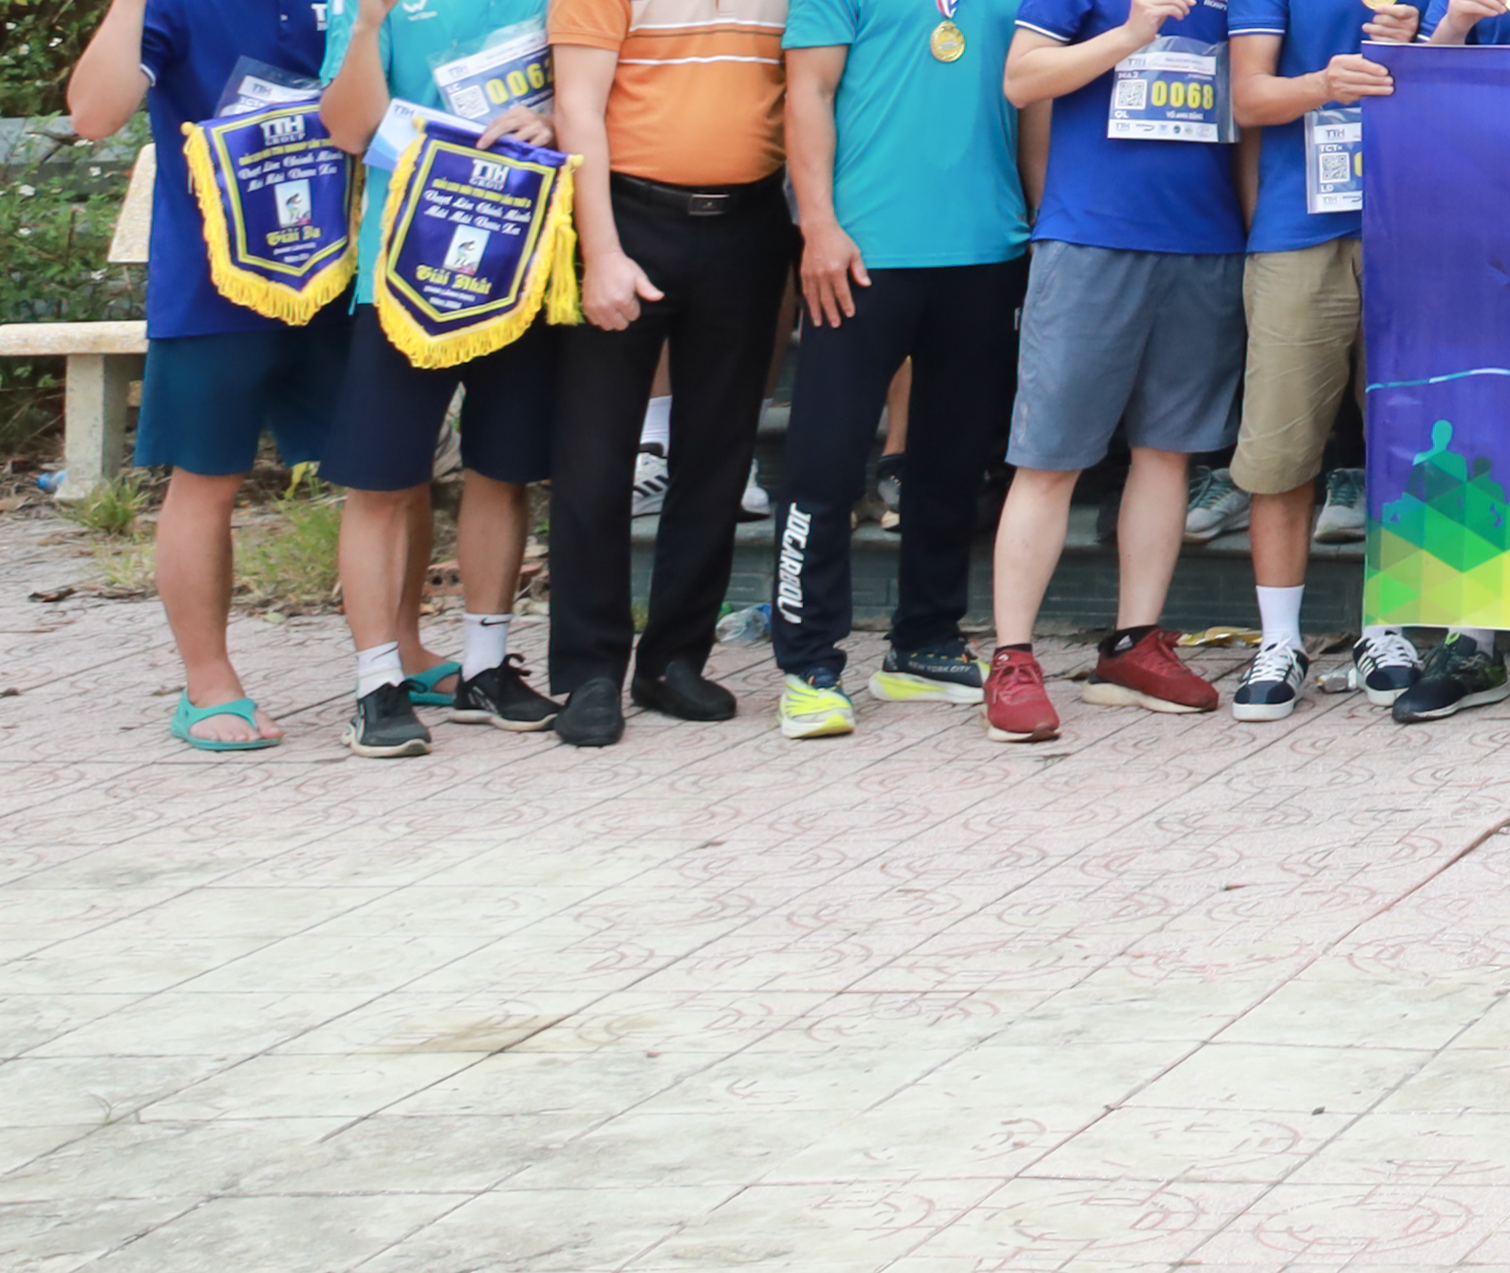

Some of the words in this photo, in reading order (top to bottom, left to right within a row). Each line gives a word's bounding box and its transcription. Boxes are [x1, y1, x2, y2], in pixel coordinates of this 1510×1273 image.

[1150, 81, 1214, 110] 0068
[260, 115, 305, 139] TTH
[472, 158, 509, 180] TTH
